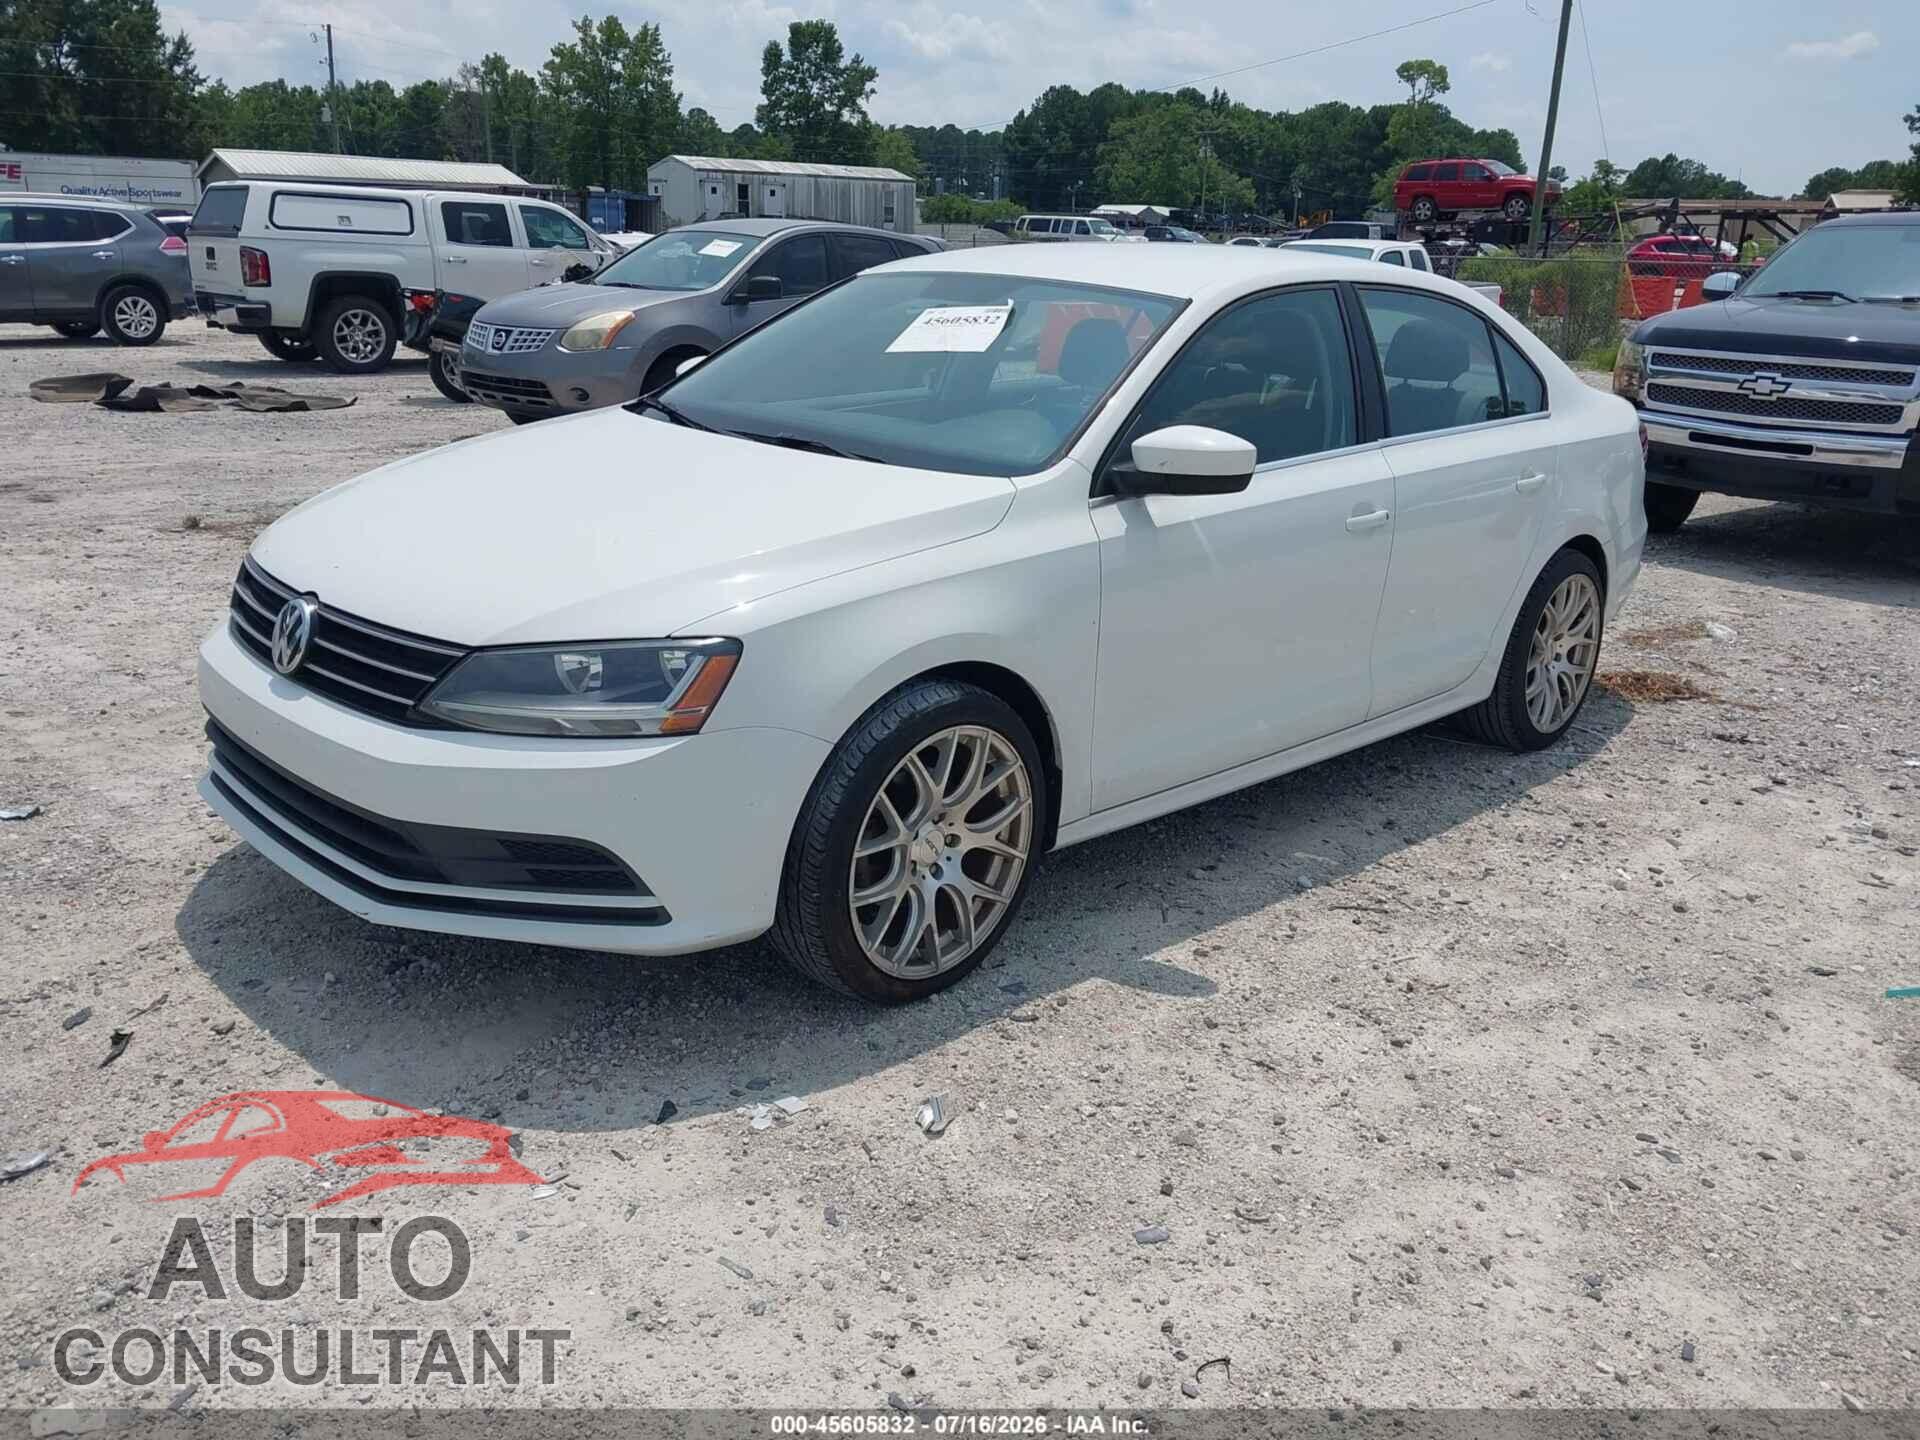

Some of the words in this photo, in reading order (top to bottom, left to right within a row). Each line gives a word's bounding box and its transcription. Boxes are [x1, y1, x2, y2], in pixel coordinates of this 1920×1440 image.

[61, 184, 97, 196] Quality
[99, 186, 127, 196] Active
[128, 187, 182, 199] Sportswear
[923, 315, 1001, 325] 45605832
